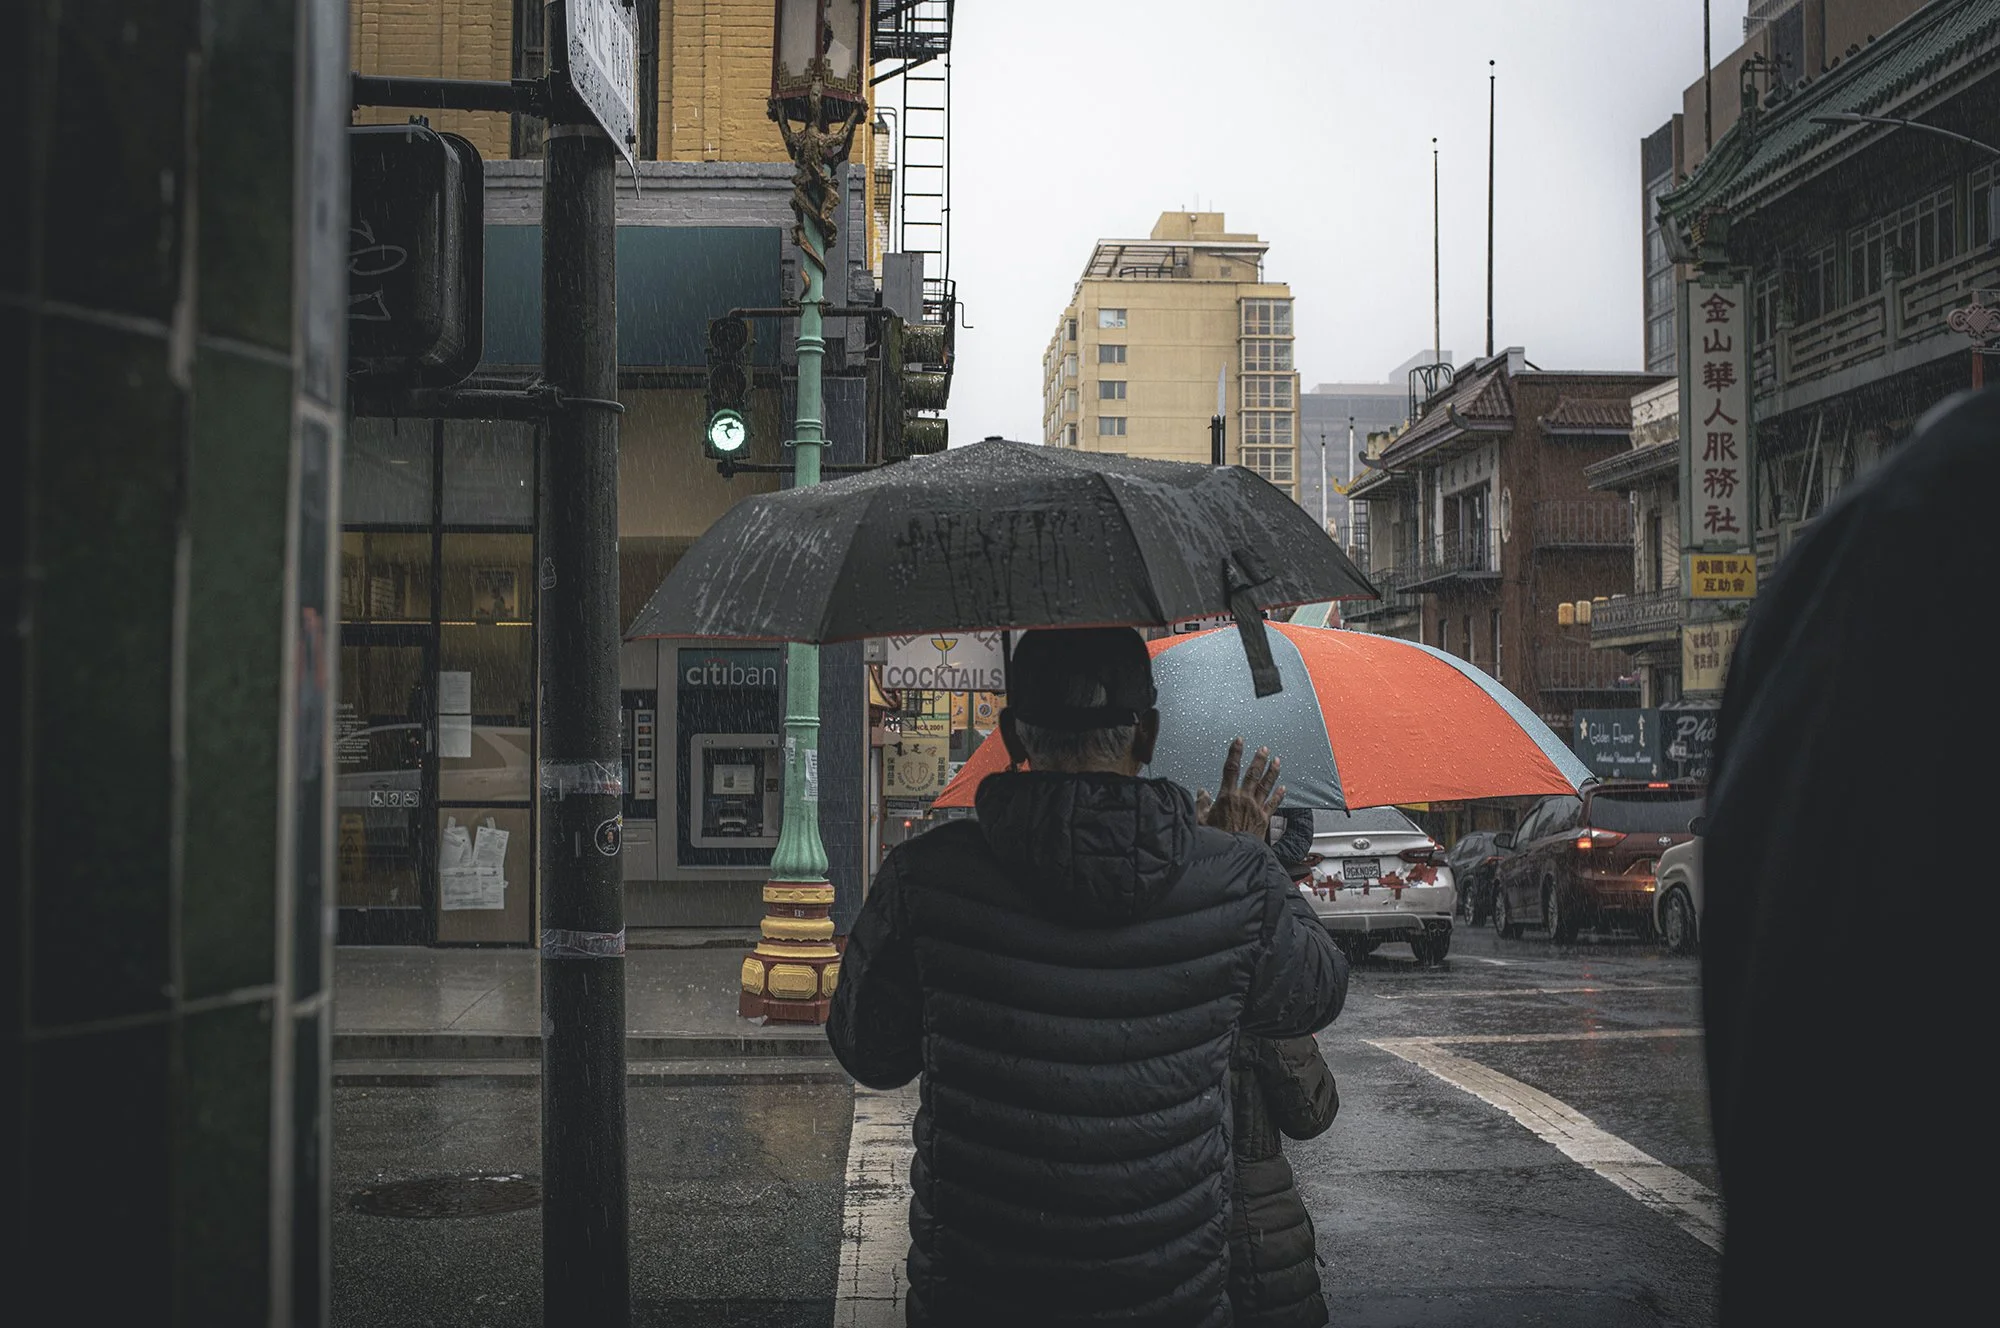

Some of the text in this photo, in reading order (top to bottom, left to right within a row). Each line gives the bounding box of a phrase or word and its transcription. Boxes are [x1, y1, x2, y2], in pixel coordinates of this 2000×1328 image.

[1700, 292, 1741, 535] 金山華人服務社
[1696, 560, 1753, 574] 美國華人
[1703, 578, 1745, 592] 互助會
[686, 658, 777, 686] citiban
[887, 666, 1003, 689] COCKTAILS
